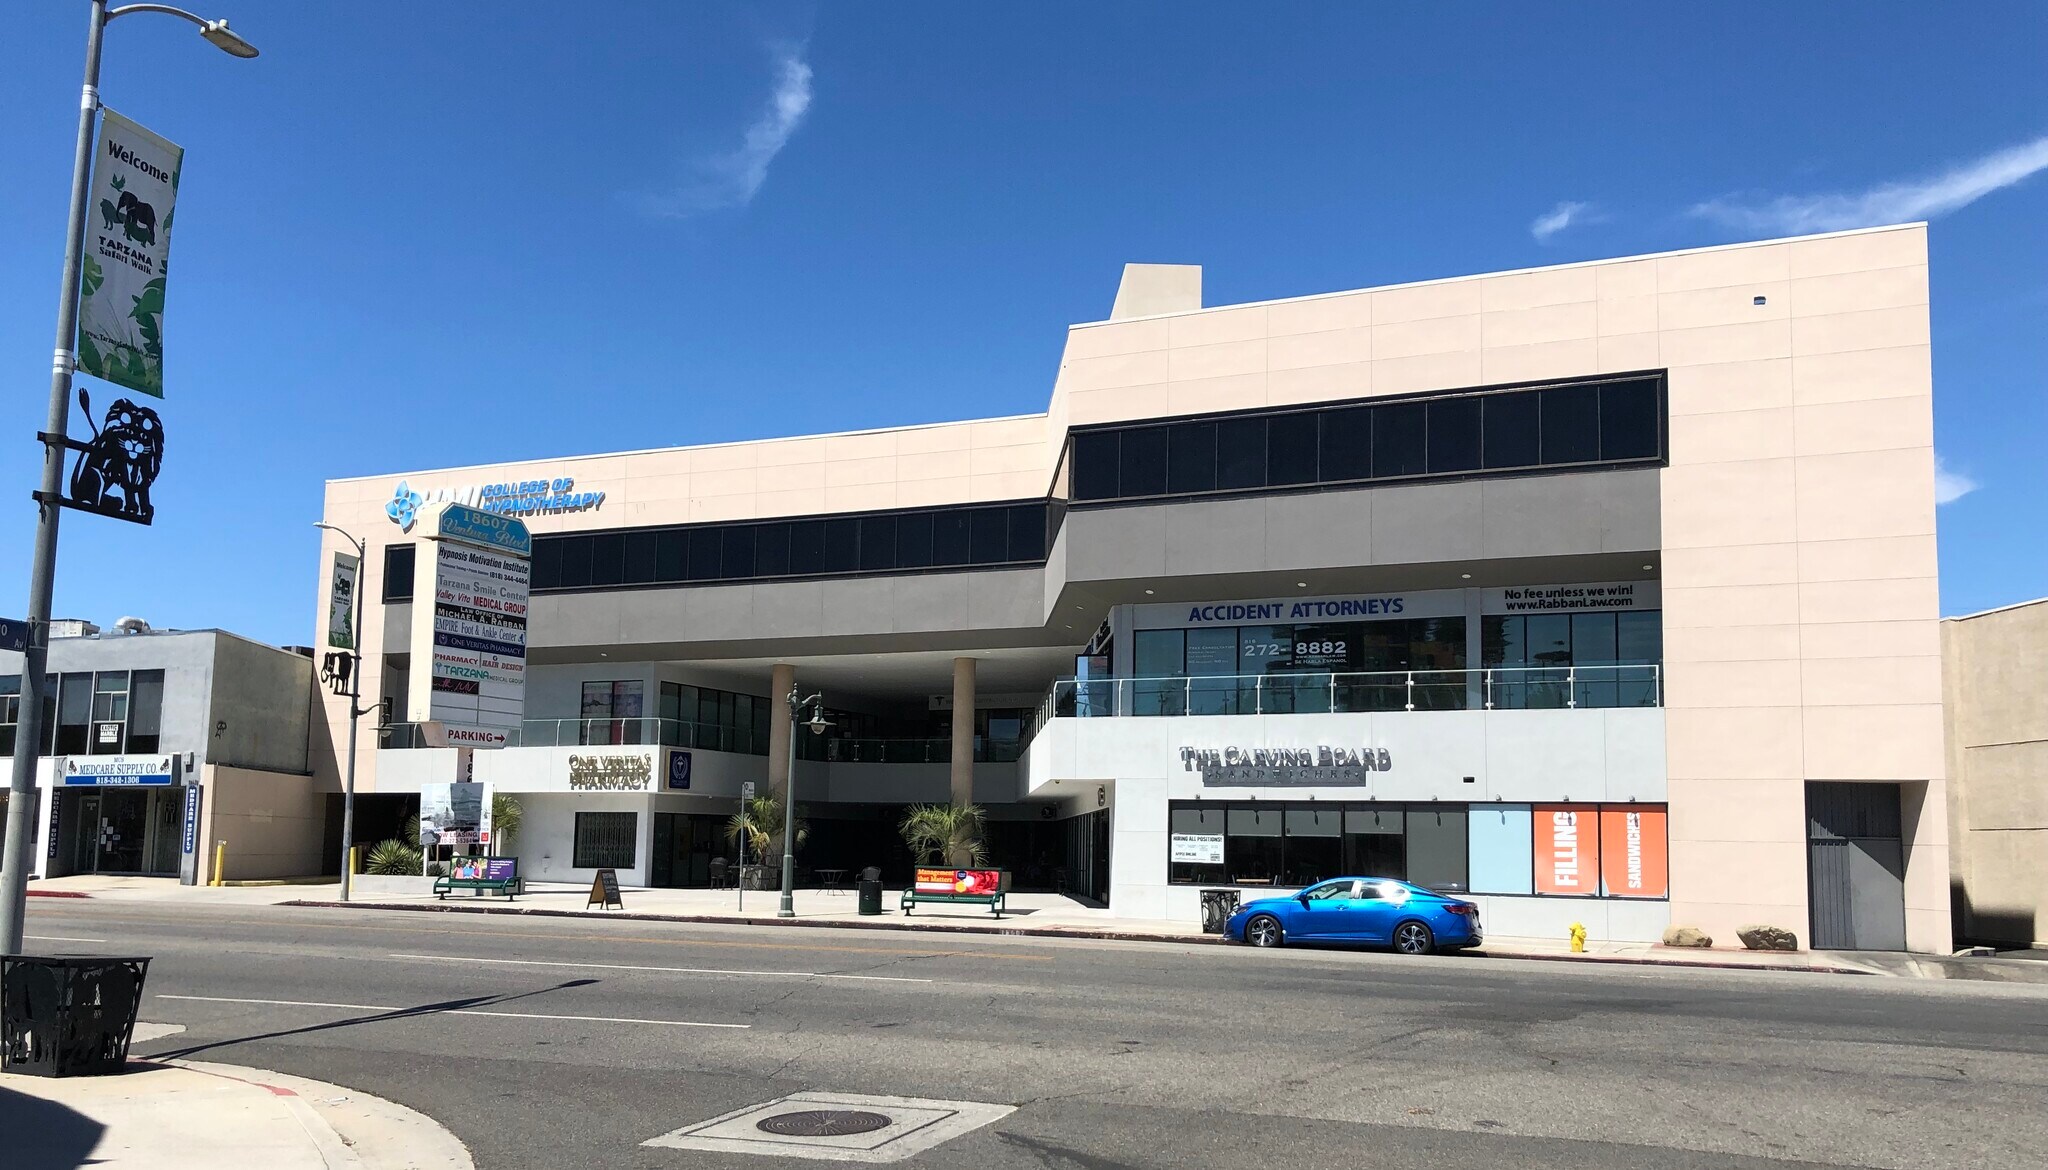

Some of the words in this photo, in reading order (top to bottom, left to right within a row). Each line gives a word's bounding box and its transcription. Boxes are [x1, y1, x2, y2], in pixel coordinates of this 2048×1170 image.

[108, 139, 169, 184] Welcome
[98, 235, 153, 267] TARZANA
[99, 246, 128, 265] Safari
[131, 258, 152, 276] Walk
[483, 478, 550, 498] COLLEGE
[551, 477, 574, 493] OF
[483, 491, 605, 514] HYPNOTHERAPY
[463, 509, 510, 531] 18607
[443, 517, 489, 540] Ventura
[495, 529, 528, 551] Blvd
[439, 546, 468, 562] Hypnosis
[469, 553, 502, 569] Motivation
[503, 560, 529, 574] Institute
[490, 571, 503, 580] (818)
[438, 574, 470, 591] Tarzana
[473, 581, 497, 596] Smile
[500, 586, 526, 602] Center
[1504, 589, 1522, 600] No
[1524, 588, 1543, 599] fee
[1545, 586, 1584, 598] unless
[1586, 587, 1605, 597] we
[1607, 584, 1634, 596] win!
[436, 588, 455, 603] Valley
[457, 592, 471, 604] Vita
[473, 595, 503, 611] MEDICAL
[504, 601, 526, 615] GROUP
[1188, 603, 1284, 622] ACCIDENT
[1290, 597, 1404, 618] ATTORNEYS
[1505, 596, 1633, 611] www.RabbanLaw.com
[437, 607, 477, 622] MICHAEL
[480, 615, 488, 624] A.
[491, 617, 525, 631] RABBAN
[460, 606, 474, 614] LAW
[475, 609, 495, 619] OFFICE
[435, 618, 459, 633] EMPIRE
[461, 622, 474, 636] Foot
[475, 625, 480, 636] &
[481, 627, 498, 639] Ankle
[500, 628, 517, 642] Center
[14, 638, 24, 649] Av
[451, 637, 465, 647] ONE
[466, 639, 490, 651] VERITAS
[490, 642, 522, 656] PHARMACY
[1244, 644, 1287, 657] 272-
[1295, 641, 1347, 655] 8882
[434, 653, 479, 666] PHARMACY
[482, 660, 500, 669] HAIR
[501, 662, 524, 672] DESIGN
[444, 665, 490, 680] TARZANA
[489, 675, 508, 683] MEDICAL
[448, 729, 493, 743] PARKING
[569, 754, 598, 772] ONE
[599, 753, 652, 772] VERITAS
[1179, 745, 1221, 766] THE
[1223, 745, 1311, 766] CARVING
[1317, 744, 1391, 767] BOARD
[79, 764, 115, 775] MEDCARE
[117, 763, 145, 775] SUPPLY
[146, 763, 158, 774] CO.
[1215, 769, 1351, 779] SANDWICHES
[96, 776, 140, 784] 818-342-1306
[569, 772, 652, 790] PHARMACY
[52, 791, 60, 824] MEDCARE
[188, 789, 196, 821] MEDCARE
[49, 828, 57, 856] SUPPLY
[1552, 811, 1579, 886] FILLING
[1626, 811, 1642, 889] SANDWICHES
[918, 869, 955, 877] Management
[918, 875, 930, 883] that
[930, 875, 954, 883] Matters
